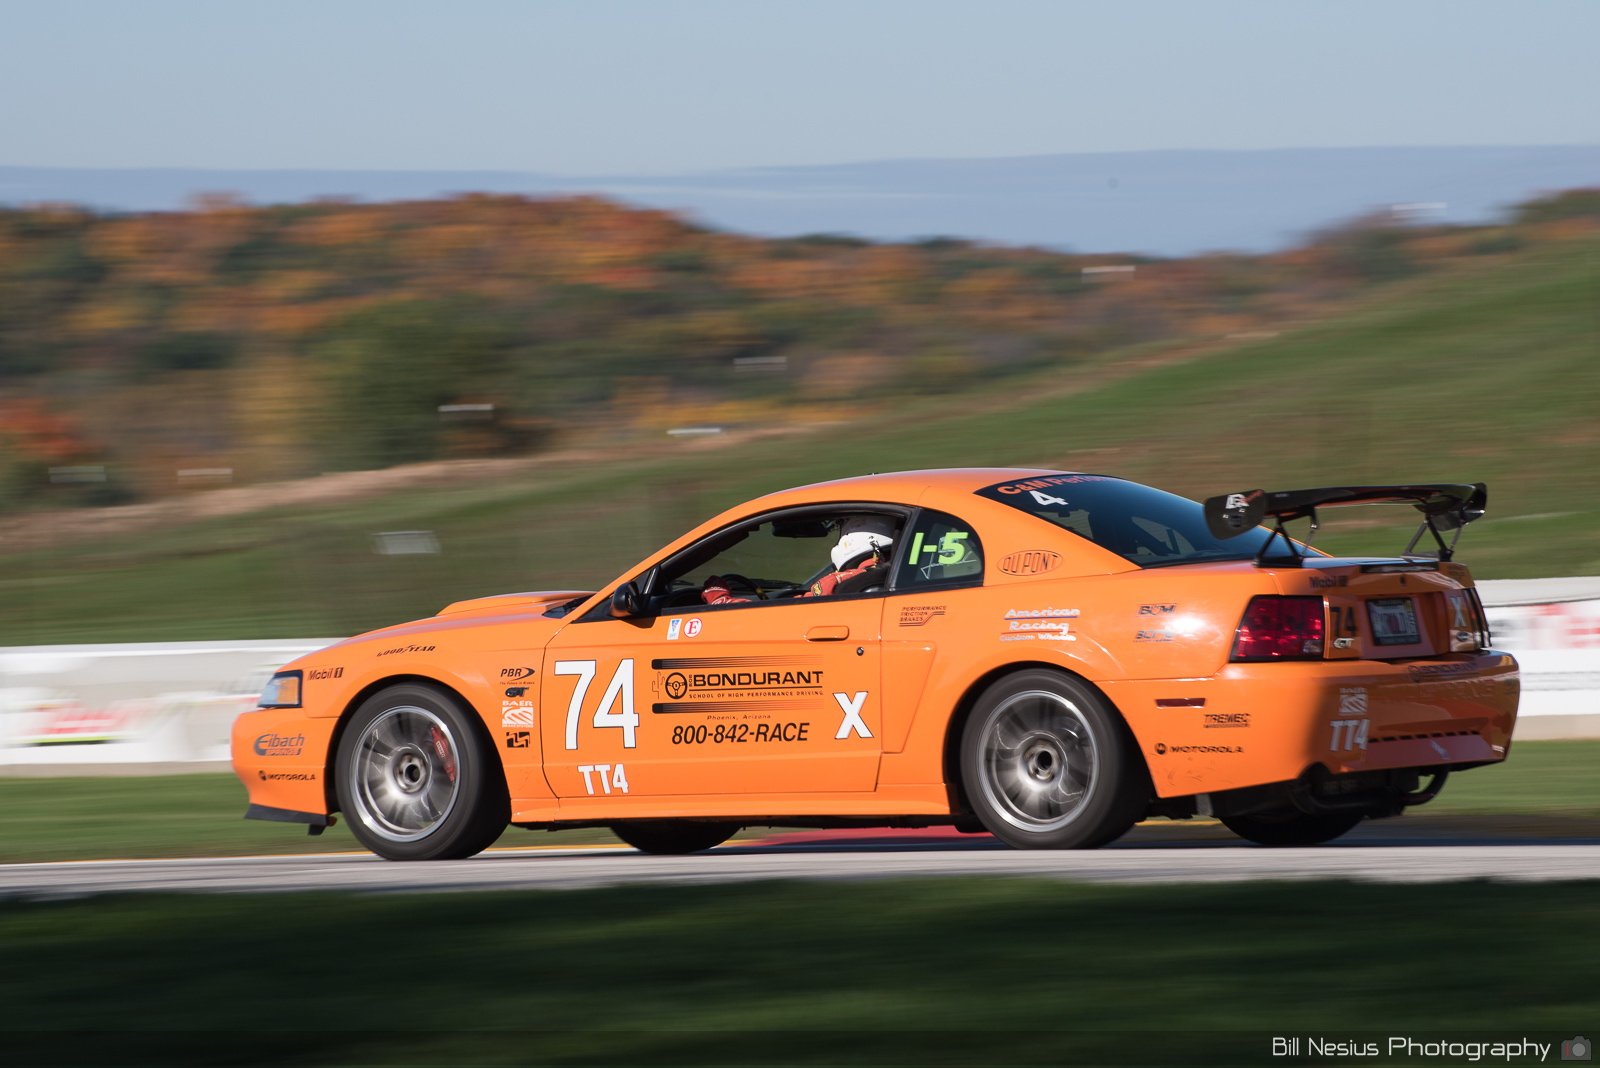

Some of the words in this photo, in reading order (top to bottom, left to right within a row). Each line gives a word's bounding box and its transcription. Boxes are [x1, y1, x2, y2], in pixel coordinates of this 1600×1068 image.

[997, 479, 1054, 495] C&M
[1029, 490, 1069, 506] 4
[1004, 606, 1080, 618] American
[1450, 596, 1467, 628] X
[687, 620, 699, 635] E
[1009, 620, 1070, 635] Racing
[1330, 606, 1357, 637] 74
[307, 667, 333, 681] Mobil
[500, 668, 522, 677] PBR
[693, 671, 823, 687] BONDURANT
[554, 657, 640, 750] 74
[832, 691, 875, 740] X
[1203, 713, 1251, 724] TREMEC
[671, 722, 810, 745] 800-842-RACE
[1329, 718, 1371, 752] TT4
[255, 733, 305, 755] Eibach
[1169, 745, 1244, 753] MOTOROLA
[268, 773, 316, 782] MOTOROLA
[577, 763, 629, 795] TT4
